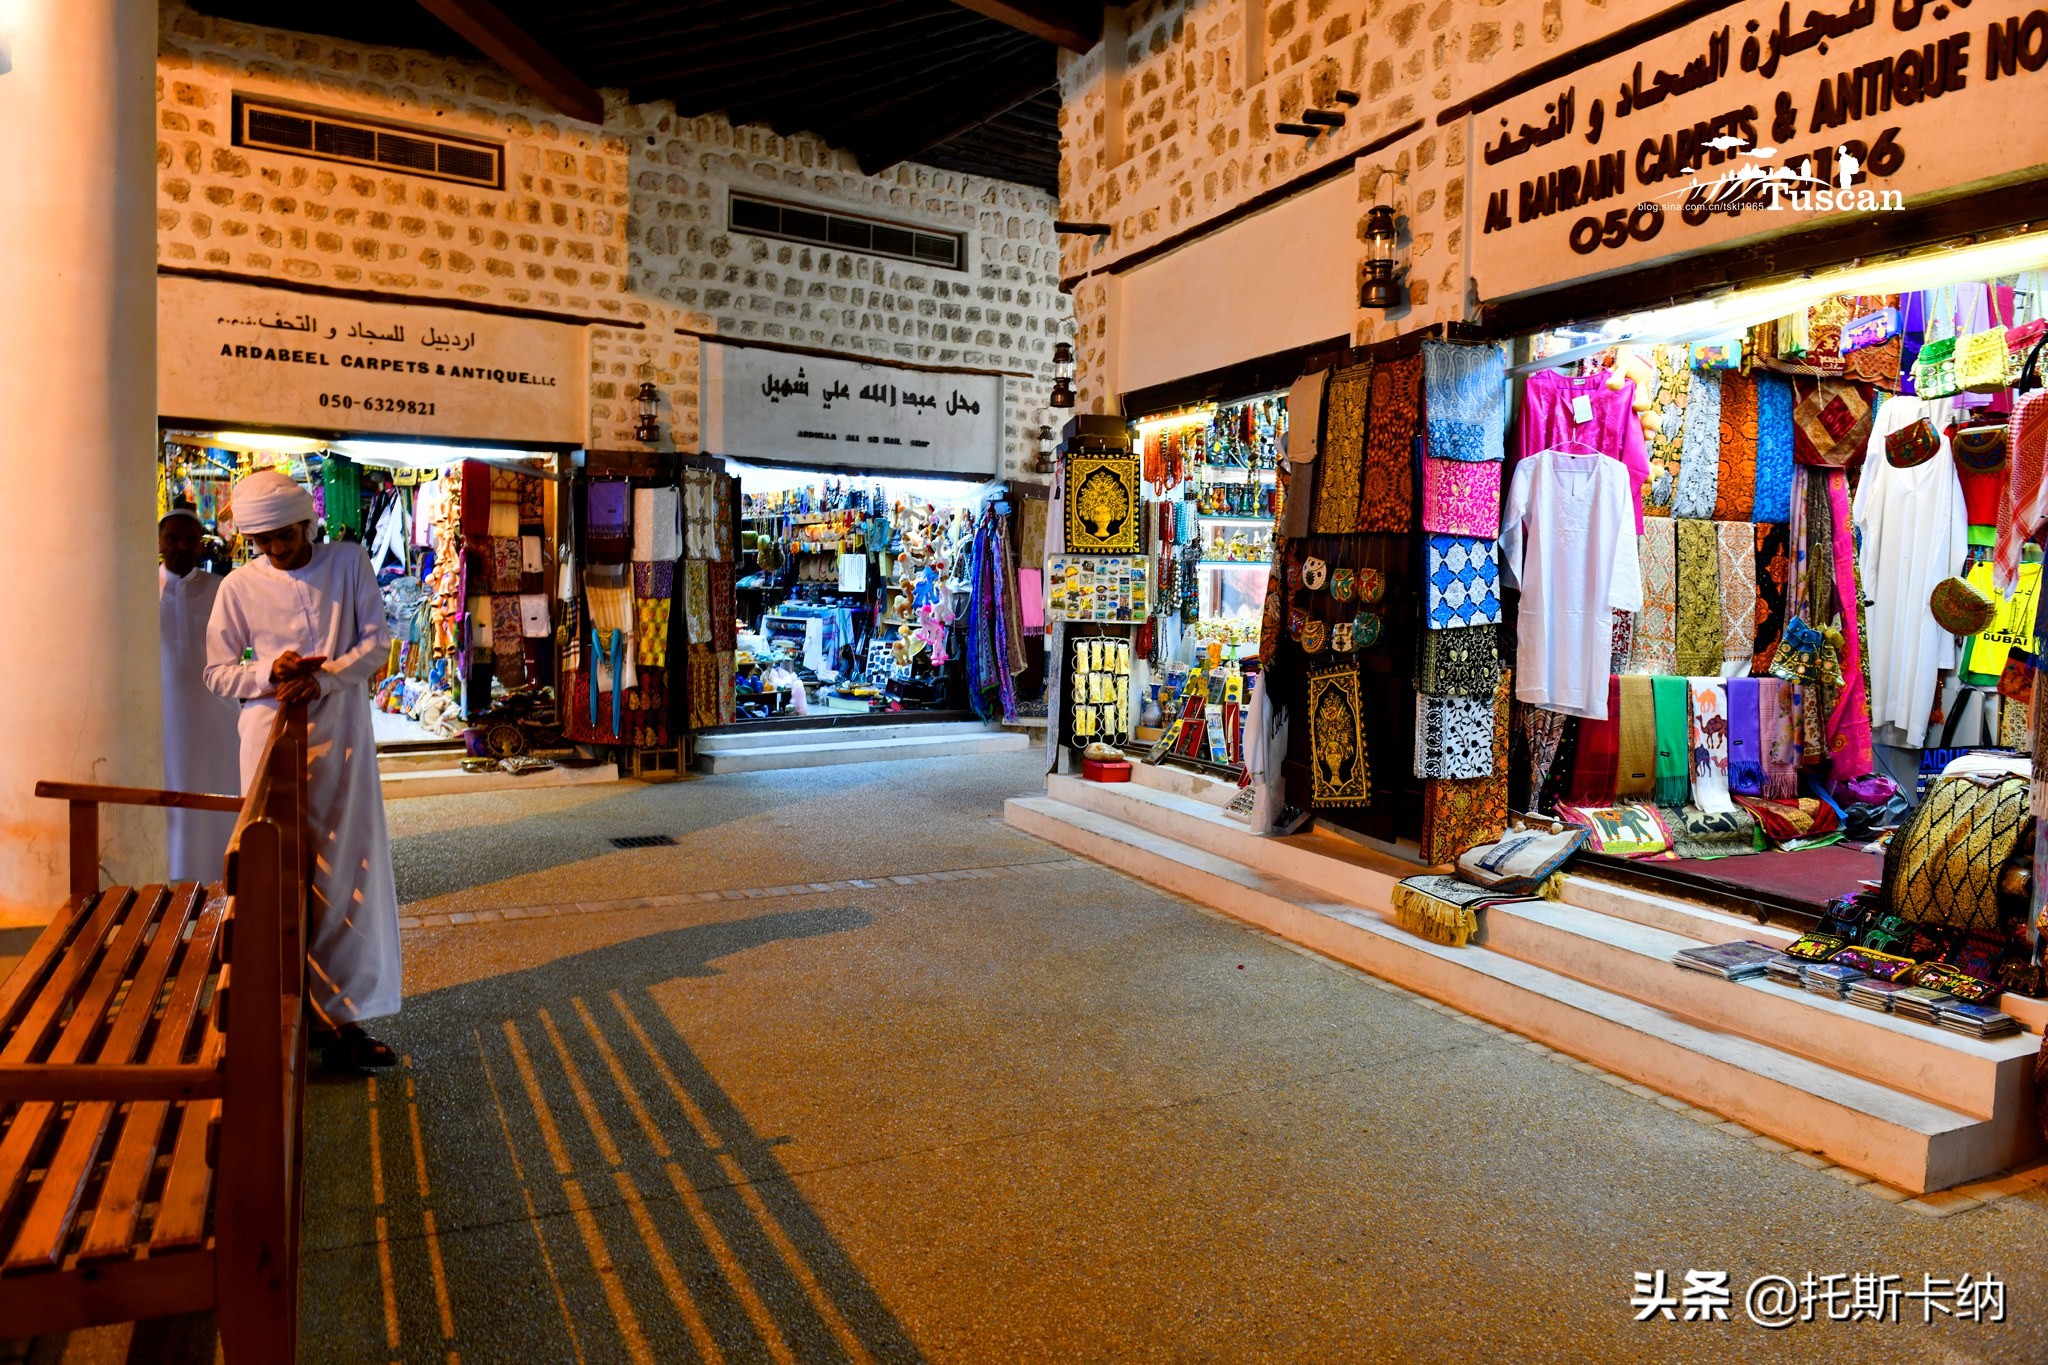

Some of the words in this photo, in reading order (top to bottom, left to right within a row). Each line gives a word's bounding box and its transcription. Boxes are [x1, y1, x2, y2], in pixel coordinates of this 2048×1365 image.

[1483, 188, 1512, 235] AL
[1519, 149, 1626, 224] BAHRAIN
[1636, 104, 1759, 186] CARPETS
[1771, 91, 1798, 145] &
[1808, 31, 1970, 134] ANTIQUE
[1585, 98, 1605, 145] و
[1569, 200, 1665, 256] 050
[324, 327, 338, 340] و
[347, 321, 405, 345] للسجاد
[421, 327, 475, 352] اردبيل
[220, 343, 330, 366] ARDABEEL
[340, 354, 429, 374] CARPETS
[435, 364, 446, 376] &
[762, 367, 809, 403] شهيل
[822, 380, 850, 410] علي
[319, 393, 436, 416] 050-6329821
[946, 389, 980, 416] محل
[1983, 632, 2028, 647] DUBAI
